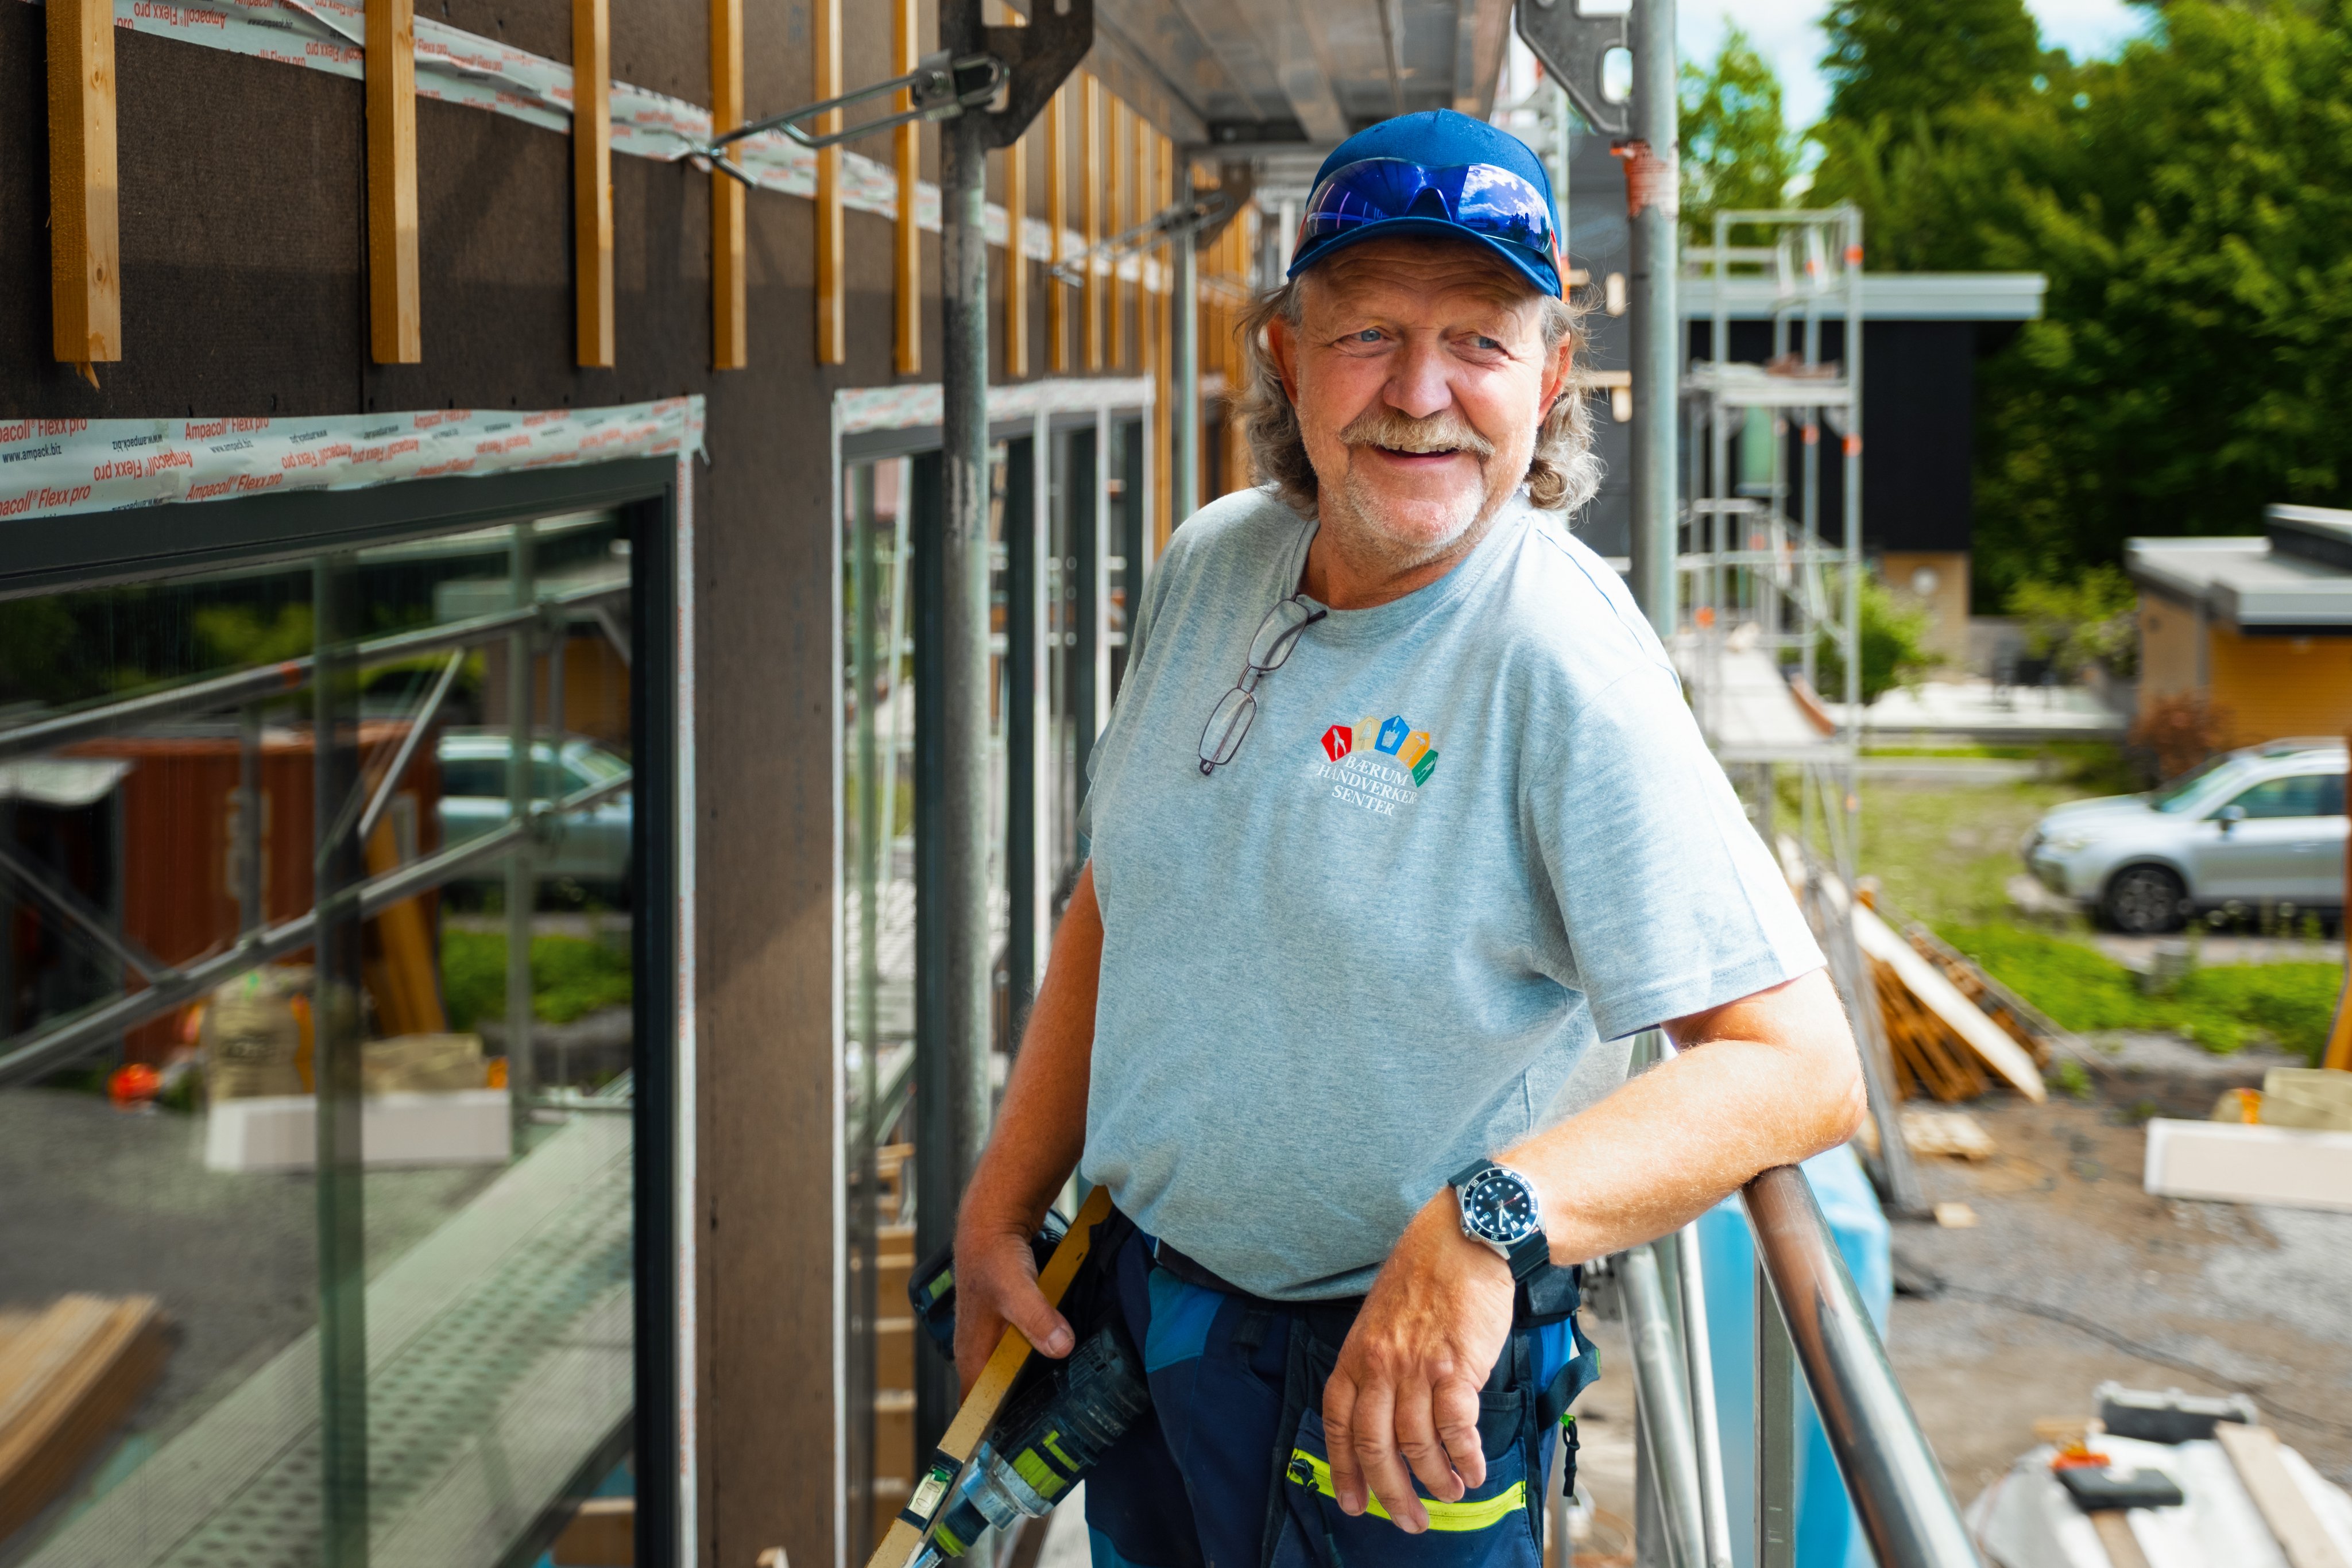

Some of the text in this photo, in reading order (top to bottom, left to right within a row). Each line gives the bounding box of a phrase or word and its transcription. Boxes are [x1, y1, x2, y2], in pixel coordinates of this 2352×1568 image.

[134, 0, 150, 18] pro
[153, 4, 178, 26] Flexx
[38, 418, 67, 438] Flexx
[69, 418, 87, 437] pro
[231, 417, 253, 433] Flexx
[255, 417, 269, 433] pro
[2, 442, 62, 463] www.ampack.biz
[112, 433, 163, 452] www.ampack.biz
[94, 460, 112, 481] pro
[114, 459, 142, 479] Flexx
[237, 474, 267, 493] Flexx
[266, 473, 283, 487] pro
[38, 487, 70, 509] Flexx
[69, 485, 91, 506] pro
[1344, 756, 1409, 787] BÆRUM
[1332, 784, 1395, 816] SENTER
